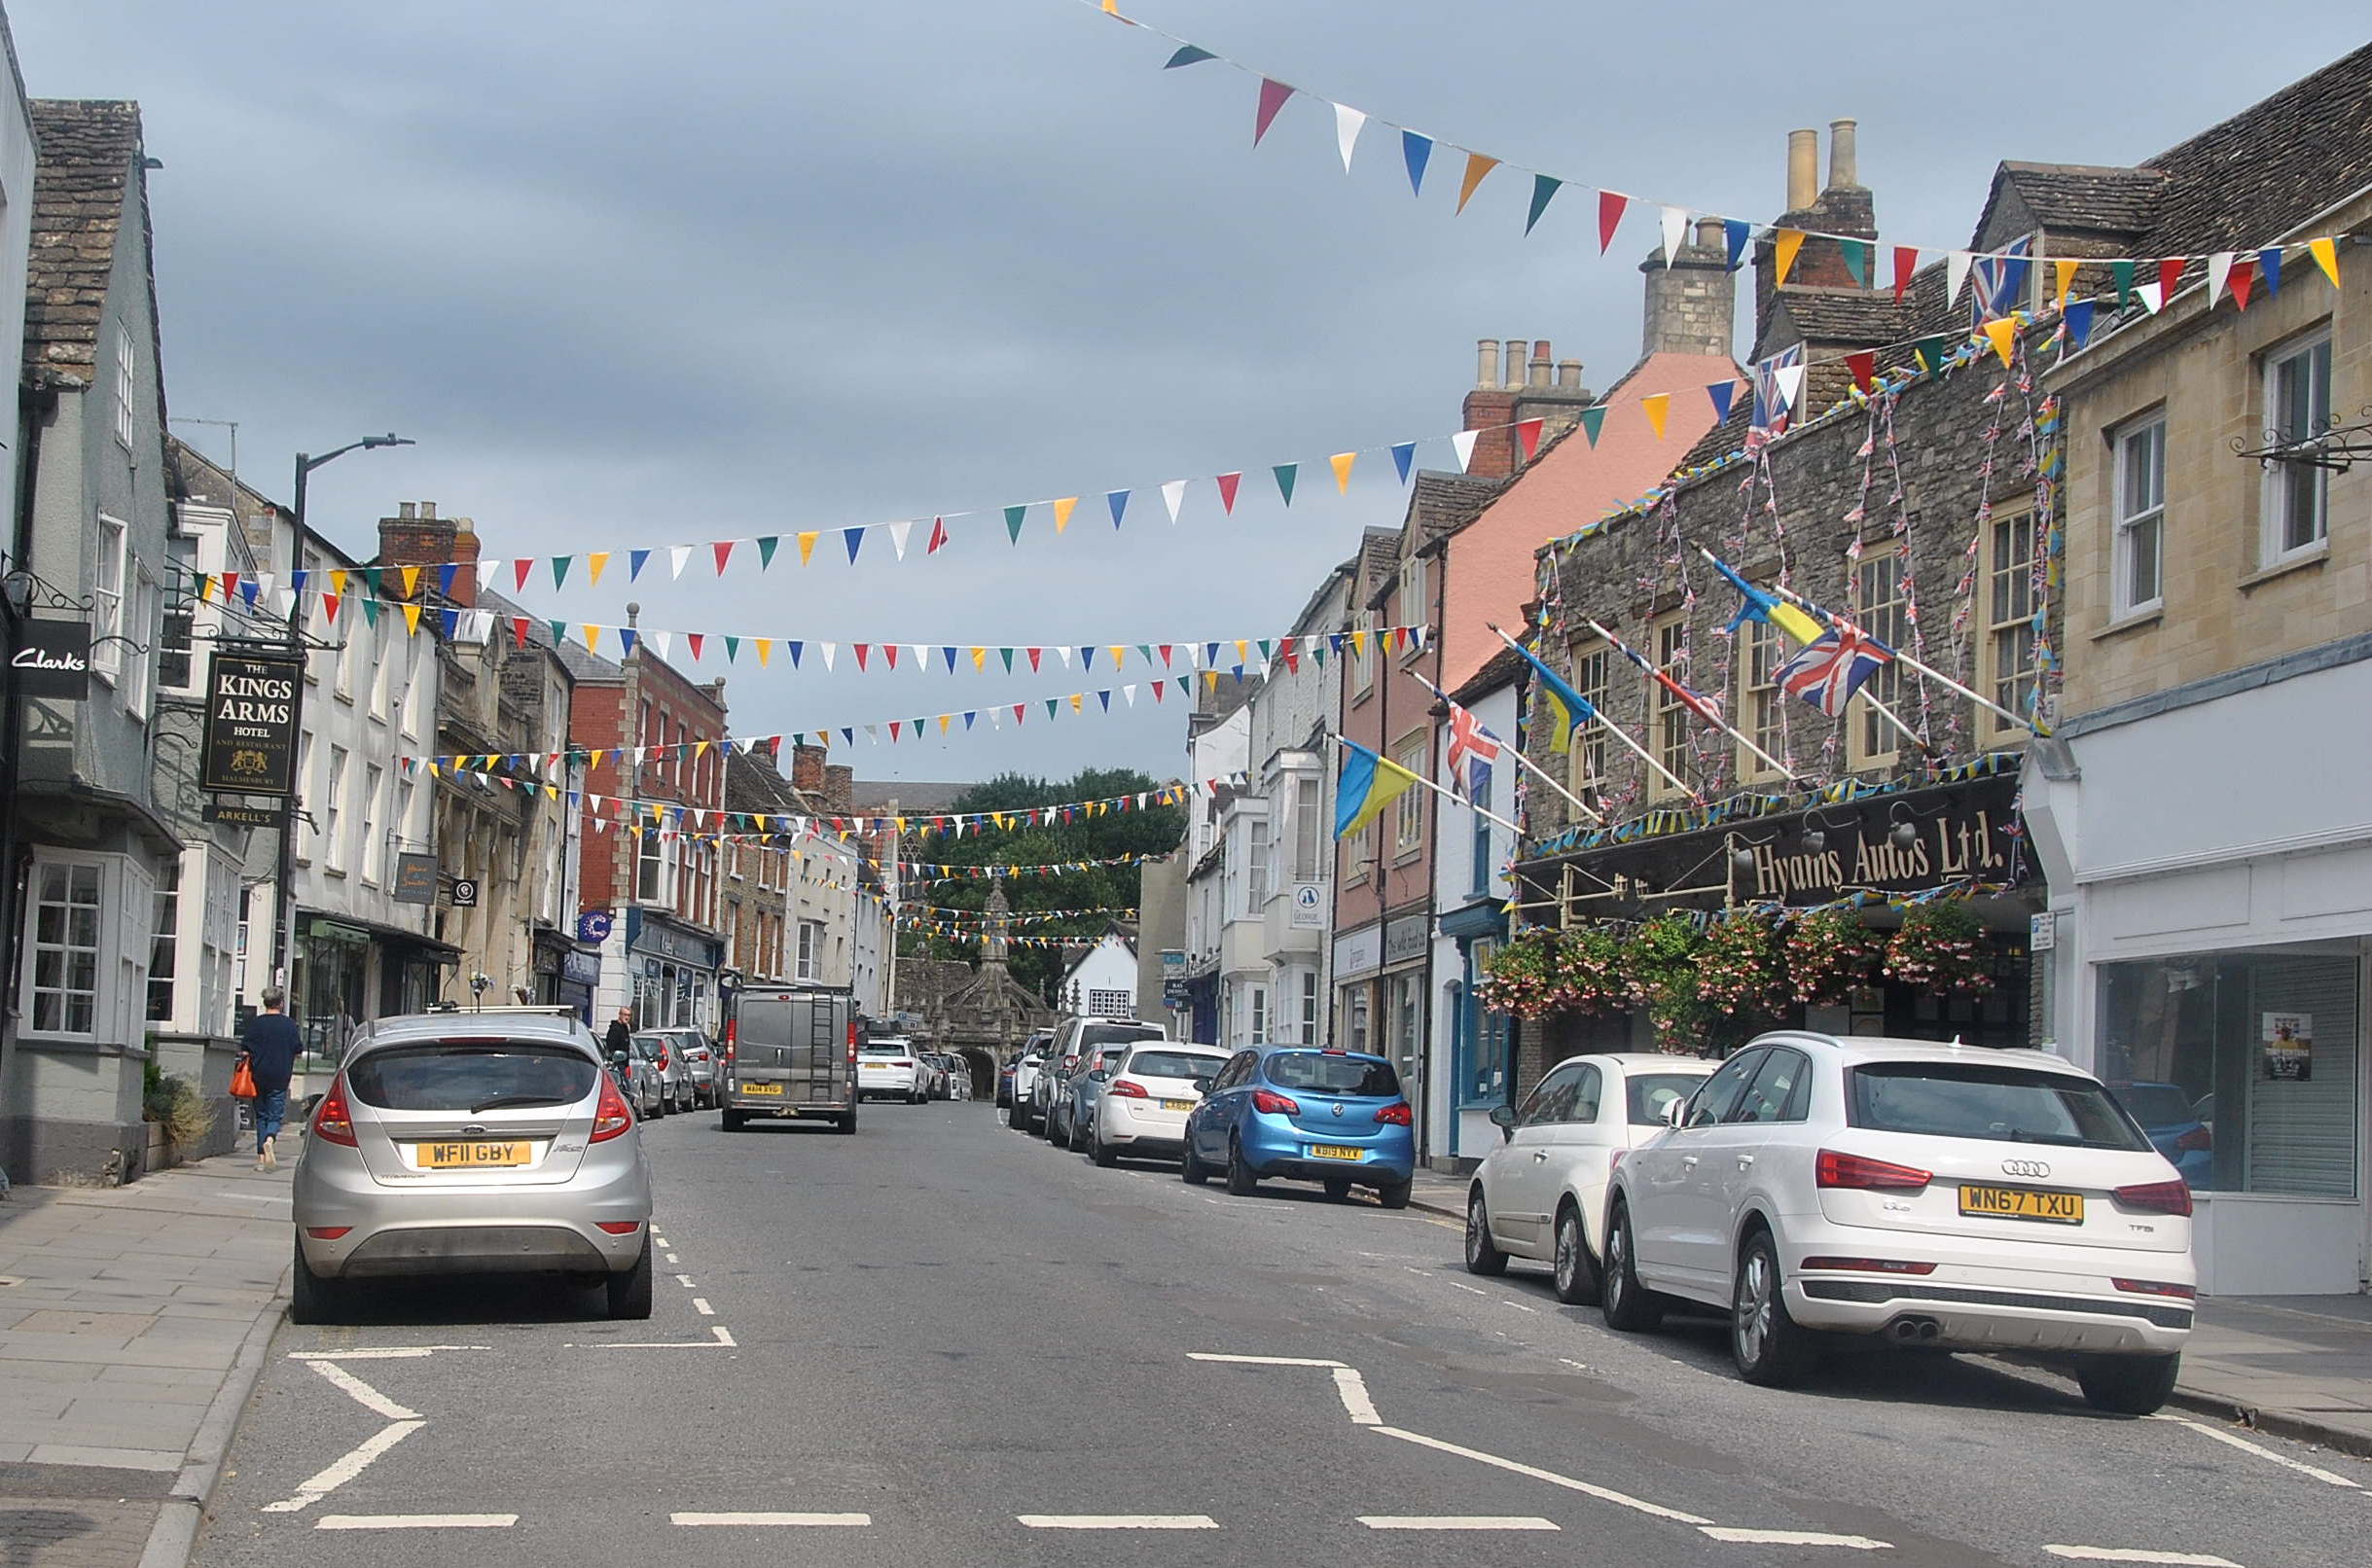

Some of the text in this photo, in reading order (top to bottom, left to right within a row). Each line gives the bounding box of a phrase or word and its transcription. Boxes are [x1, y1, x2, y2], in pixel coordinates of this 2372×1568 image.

[12, 648, 86, 671] Clarks
[244, 664, 269, 674] THE
[218, 674, 292, 699] KINGS
[217, 698, 289, 724] ARMS
[234, 727, 270, 738] HOTEL
[235, 741, 287, 750] RESTAURANT
[217, 810, 271, 823] ARKELL'S
[1752, 810, 2003, 906] Hyams Autos Ltd.
[433, 1144, 515, 1162] WF11 GBY
[1970, 1188, 2075, 1216] WN67 TXU
